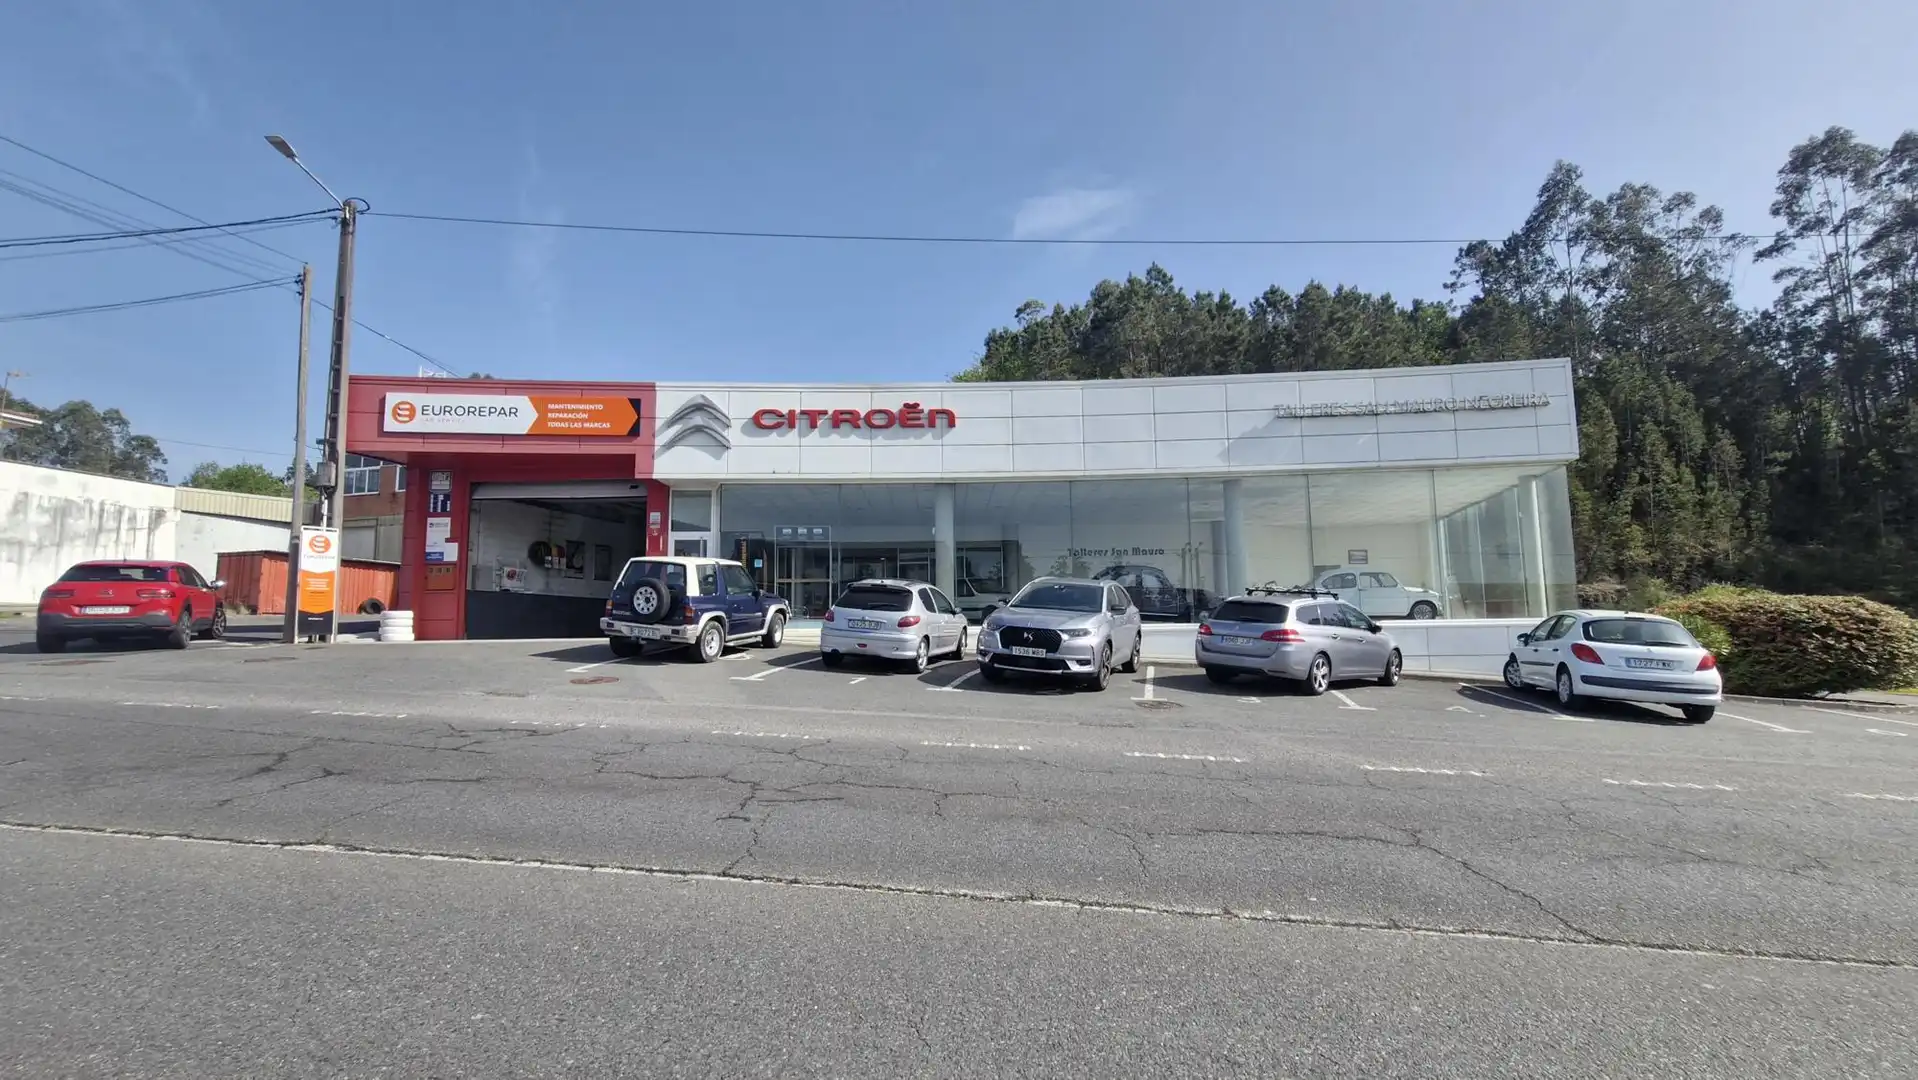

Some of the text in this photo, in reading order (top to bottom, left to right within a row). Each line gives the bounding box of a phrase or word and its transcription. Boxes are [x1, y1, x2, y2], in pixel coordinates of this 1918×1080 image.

[421, 405, 518, 417] EUROREPAR
[1274, 393, 1551, 418] TALLERES SAN MAURO NEGREIRA
[1067, 547, 1108, 557] Talleres
[1131, 547, 1165, 556] Mauro
